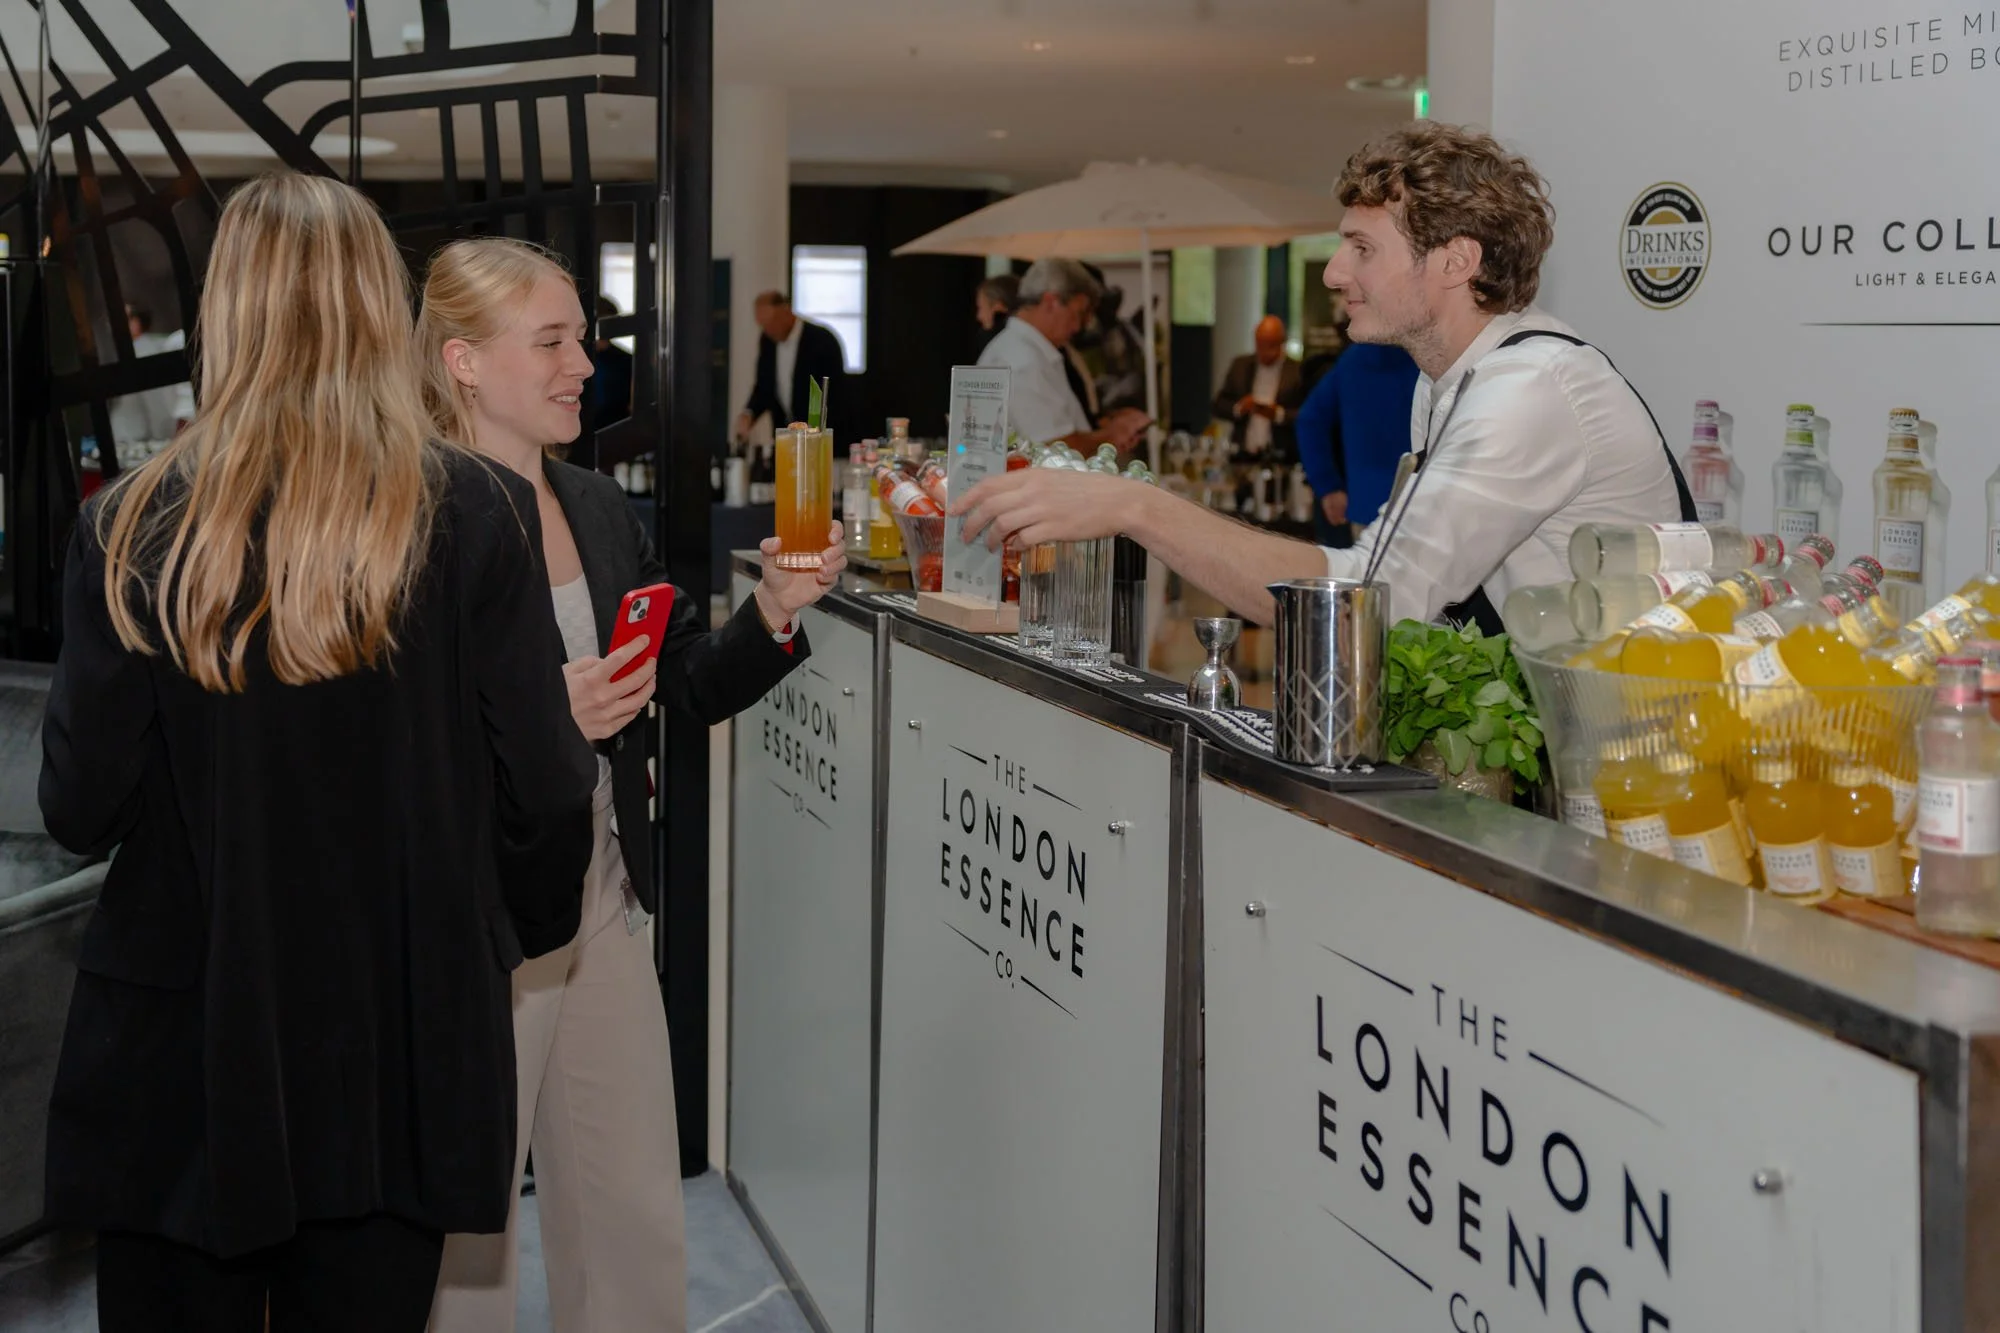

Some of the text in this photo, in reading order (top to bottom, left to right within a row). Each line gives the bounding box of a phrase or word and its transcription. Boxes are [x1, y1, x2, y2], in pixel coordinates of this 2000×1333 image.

[1779, 18, 1942, 62] EXQUISITE
[1788, 52, 1948, 92] DISTILLED
[1627, 228, 1704, 254] DRINKS
[1768, 224, 1854, 257] OUR
[1855, 270, 1997, 287] LIGHT & ELEGA
[763, 681, 837, 749] ONDON
[763, 718, 837, 802] ESSENCE
[994, 754, 1026, 795] THE
[942, 778, 1086, 905] LONDON
[941, 842, 1084, 979] ESSENCE
[1431, 984, 1508, 1062] THE
[1316, 994, 1672, 1279] LONDON
